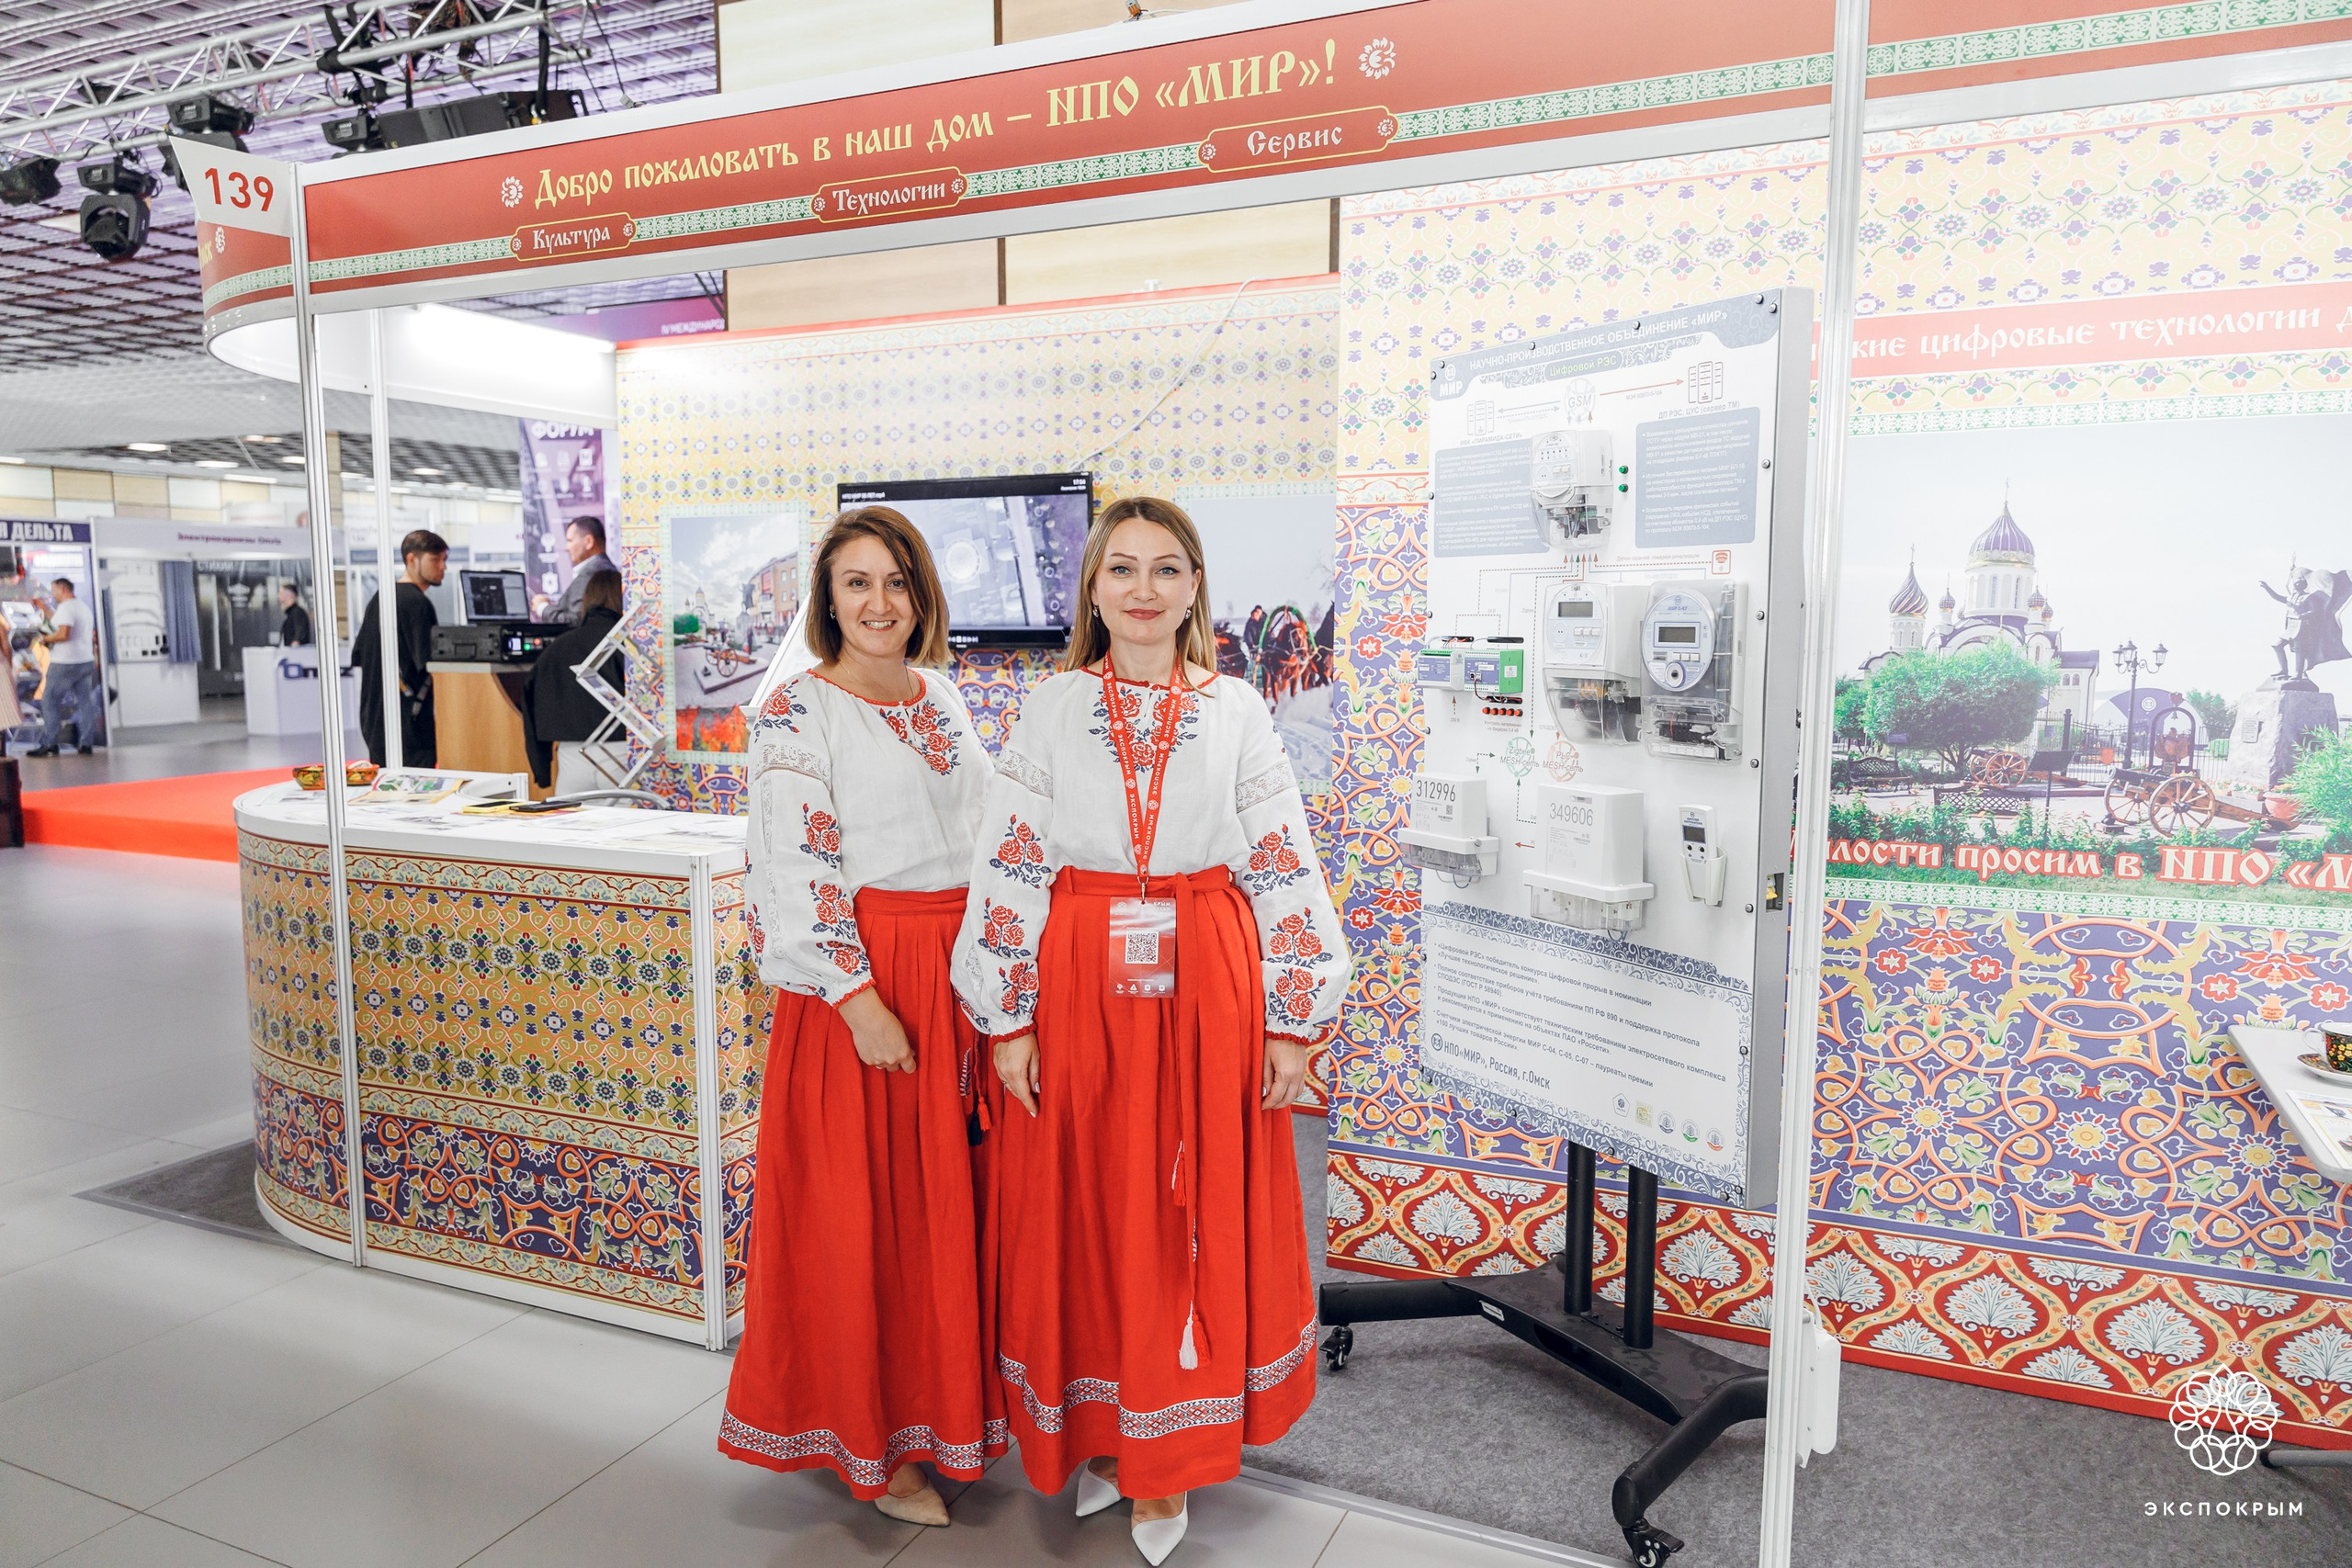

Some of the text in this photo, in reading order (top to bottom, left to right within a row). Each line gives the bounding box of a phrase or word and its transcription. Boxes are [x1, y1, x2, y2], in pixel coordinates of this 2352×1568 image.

[535, 167, 613, 210] Добро
[624, 141, 799, 189] пожаловать
[813, 136, 831, 162] в
[844, 122, 913, 158] наш
[925, 111, 994, 153] дом
[1046, 74, 1141, 128] НПО
[1154, 38, 1336, 108] «МИР»!
[1246, 123, 1343, 159] Сервис
[204, 167, 275, 213] 139
[831, 179, 946, 216] Технологии
[532, 223, 611, 254] Культура
[1469, 309, 1727, 372] НАУЧНО-ПРОИЗВОДСТВЕННОЕ ОБЪЕДИНЕНИЕ «МИР»
[1919, 321, 2096, 360] цифровые
[2109, 305, 2321, 347] технологии
[1549, 354, 1616, 378] Цифровой РЭС
[1439, 381, 1464, 398] МИР
[1568, 394, 1592, 408] GSM
[1658, 410, 1667, 420] ДП
[1685, 406, 1699, 416] ЦУС
[1700, 402, 1726, 414] (сервер
[1727, 400, 1739, 410] ТМ)
[1471, 432, 1522, 445] «ПИРАМИДА-СЕТИ»
[11, 522, 74, 541] ДЕЛЬТА
[1106, 682, 1118, 718] ЭКСПОКРЫМ
[1164, 699, 1177, 738] ЭКСПОКРЫМ
[1117, 734, 1130, 775] ЭКСПОКРЫМ
[1499, 755, 1539, 767] MESH-сеть
[1509, 746, 1530, 756] Zigbee
[1542, 760, 1583, 772] MESH-сеть
[1555, 751, 1571, 760] PLC
[1152, 753, 1164, 795] ЭКСПОКРЫМ
[1416, 779, 1455, 802] 312996
[1129, 793, 1139, 839] ЭКСПОКРЫМ
[1549, 802, 1593, 826] 349606
[1143, 814, 1154, 859] ЭКСПОКРЫМ
[1956, 845, 2101, 881] просим
[2114, 851, 2143, 877] в
[2159, 845, 2272, 885] НПО
[1437, 972, 1460, 985] СПОДЭС
[1461, 979, 1477, 990] (ГОСТ
[1438, 951, 1539, 985] «Лучшее технологическое решение».
[1438, 943, 1468, 957] «Цифровой
[1469, 951, 1485, 960] РЭС»
[1485, 955, 1519, 971] победитель
[1520, 966, 1547, 979] конкурса
[1548, 972, 1581, 988] Цифровой
[1582, 982, 1607, 995] прорыв
[1614, 990, 1651, 1007] номинации
[1437, 963, 1456, 975] Полное
[1458, 971, 1495, 986] соответствие
[1496, 981, 1524, 995] приборов
[1525, 989, 1541, 1001] учёта
[1543, 994, 1583, 1013] требованиям
[1584, 1006, 1594, 1015] ПП
[1595, 1009, 1605, 1019] РФ
[1606, 1012, 1617, 1022] 890
[1624, 1019, 1661, 1036] поддержка
[1662, 1030, 1699, 1048] протокола
[1436, 1019, 1519, 1051] «100 лучших товаров России».
[1437, 985, 1725, 1082] Продукция НПО «МИР» соответствует техническим требованиям электросетевого комплекса
[1441, 996, 1480, 1014] рекомендуется
[1486, 1010, 1522, 1027] применению
[1532, 1023, 1559, 1038] объектах
[1561, 1032, 1574, 1043] ПАО
[1576, 1037, 1610, 1054] «Россети».
[1436, 1010, 1460, 1023] Счетчики
[1461, 1018, 1501, 1038] электрической
[1503, 1033, 1525, 1046] энергии
[1527, 1039, 1541, 1050] МИР
[1542, 1044, 1557, 1056] С-04,
[1558, 1049, 1573, 1062] С-05,
[1575, 1055, 1588, 1066] С-07
[1595, 1063, 1626, 1079] лауреаты
[1627, 1073, 1653, 1088] премии
[1444, 1040, 1550, 1089] НПО«МИР», Россия, г.Омск
